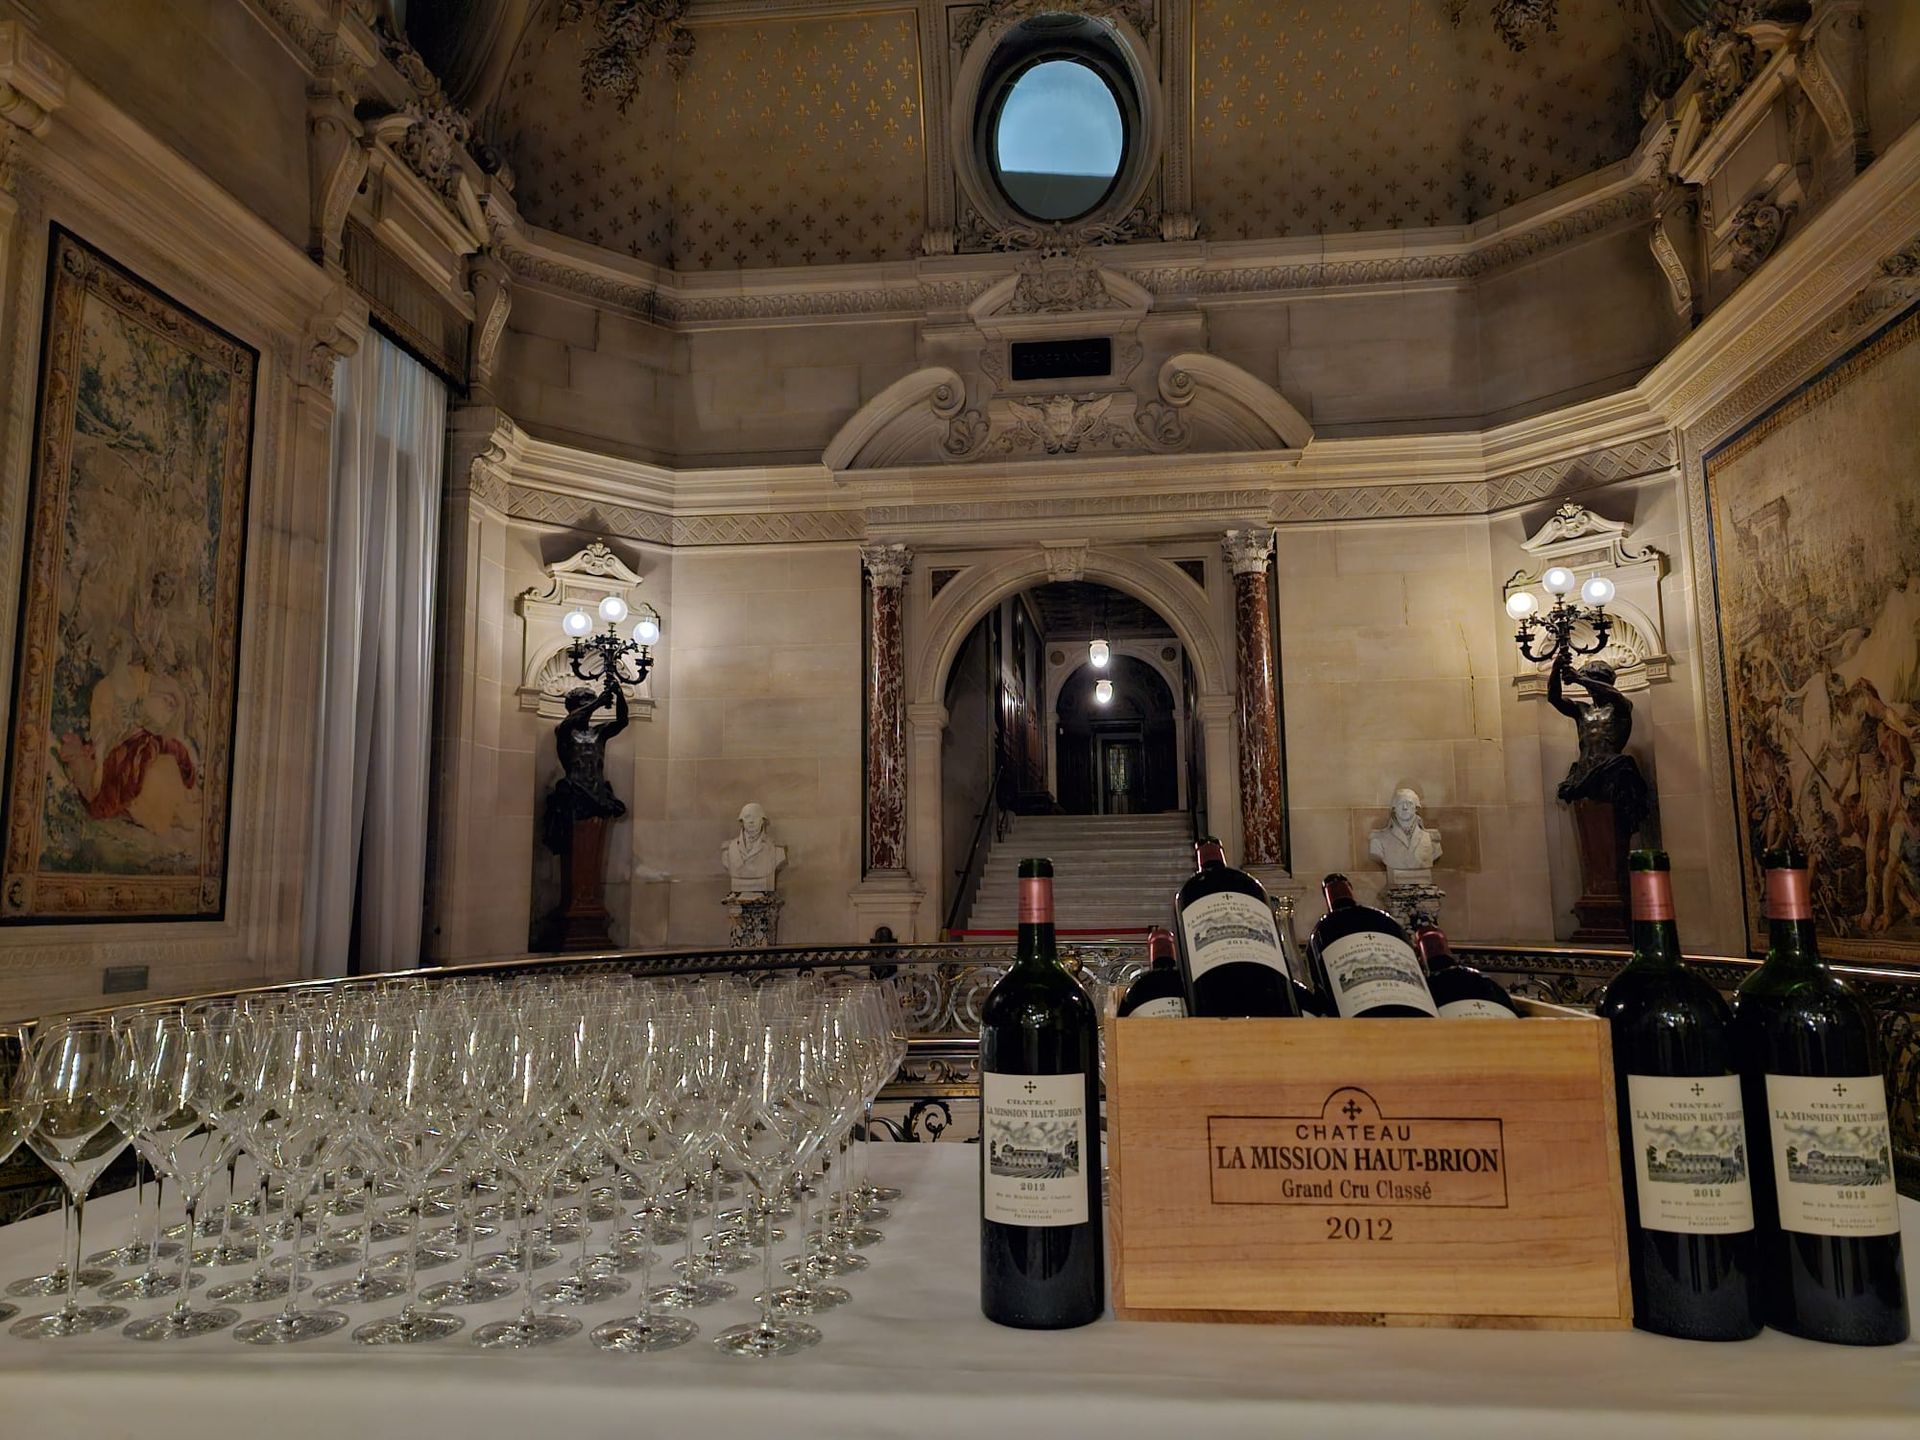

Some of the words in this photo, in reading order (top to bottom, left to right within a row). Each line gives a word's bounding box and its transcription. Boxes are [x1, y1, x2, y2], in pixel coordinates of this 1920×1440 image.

[1006, 1098, 1057, 1106] CHATEAU
[985, 1105, 993, 1115] LA
[994, 1106, 1028, 1118] MISSION
[1031, 1106, 1083, 1119] HAUT-BRION
[1636, 1109, 1650, 1120] LA
[1651, 1111, 1698, 1122] MISSION
[1775, 1109, 1789, 1120] LA
[1791, 1111, 1840, 1123] MISSION
[1295, 1124, 1411, 1141] CHATEAU
[1215, 1145, 1247, 1170] LA
[1251, 1145, 1348, 1171] MISSION
[1353, 1147, 1499, 1173] HAUT-BRION
[1019, 1182, 1046, 1192] 2012
[1281, 1178, 1333, 1199] Grand
[1340, 1179, 1370, 1199] Cru
[1376, 1179, 1432, 1200] Classé
[1326, 1216, 1393, 1241] 2012
